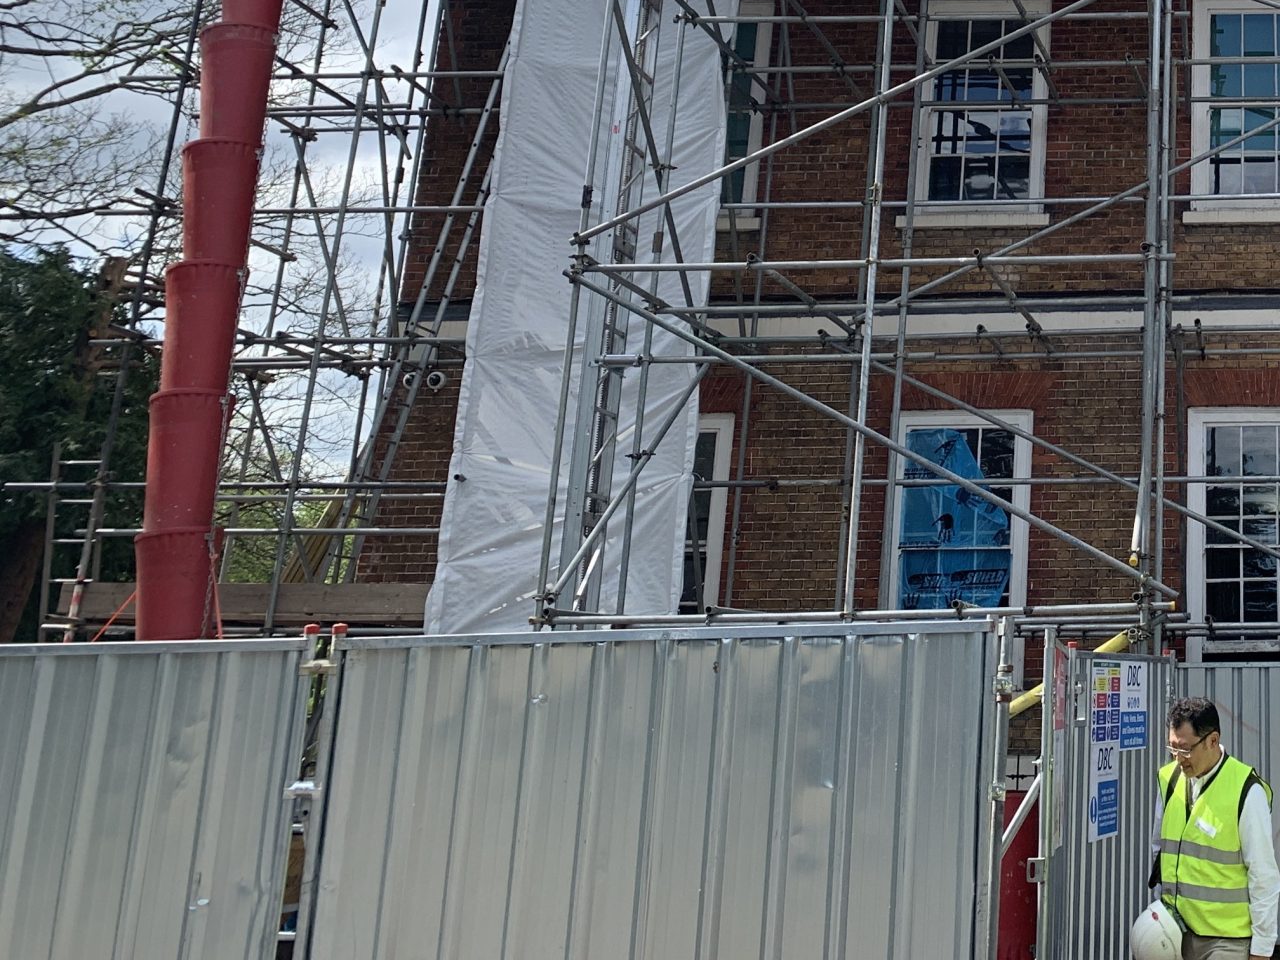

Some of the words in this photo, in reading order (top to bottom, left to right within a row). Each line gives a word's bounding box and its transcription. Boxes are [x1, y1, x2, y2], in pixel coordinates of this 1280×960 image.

[965, 571, 1004, 584] SHIELD
[1127, 665, 1141, 687] DBC
[1098, 746, 1113, 771] DBC
